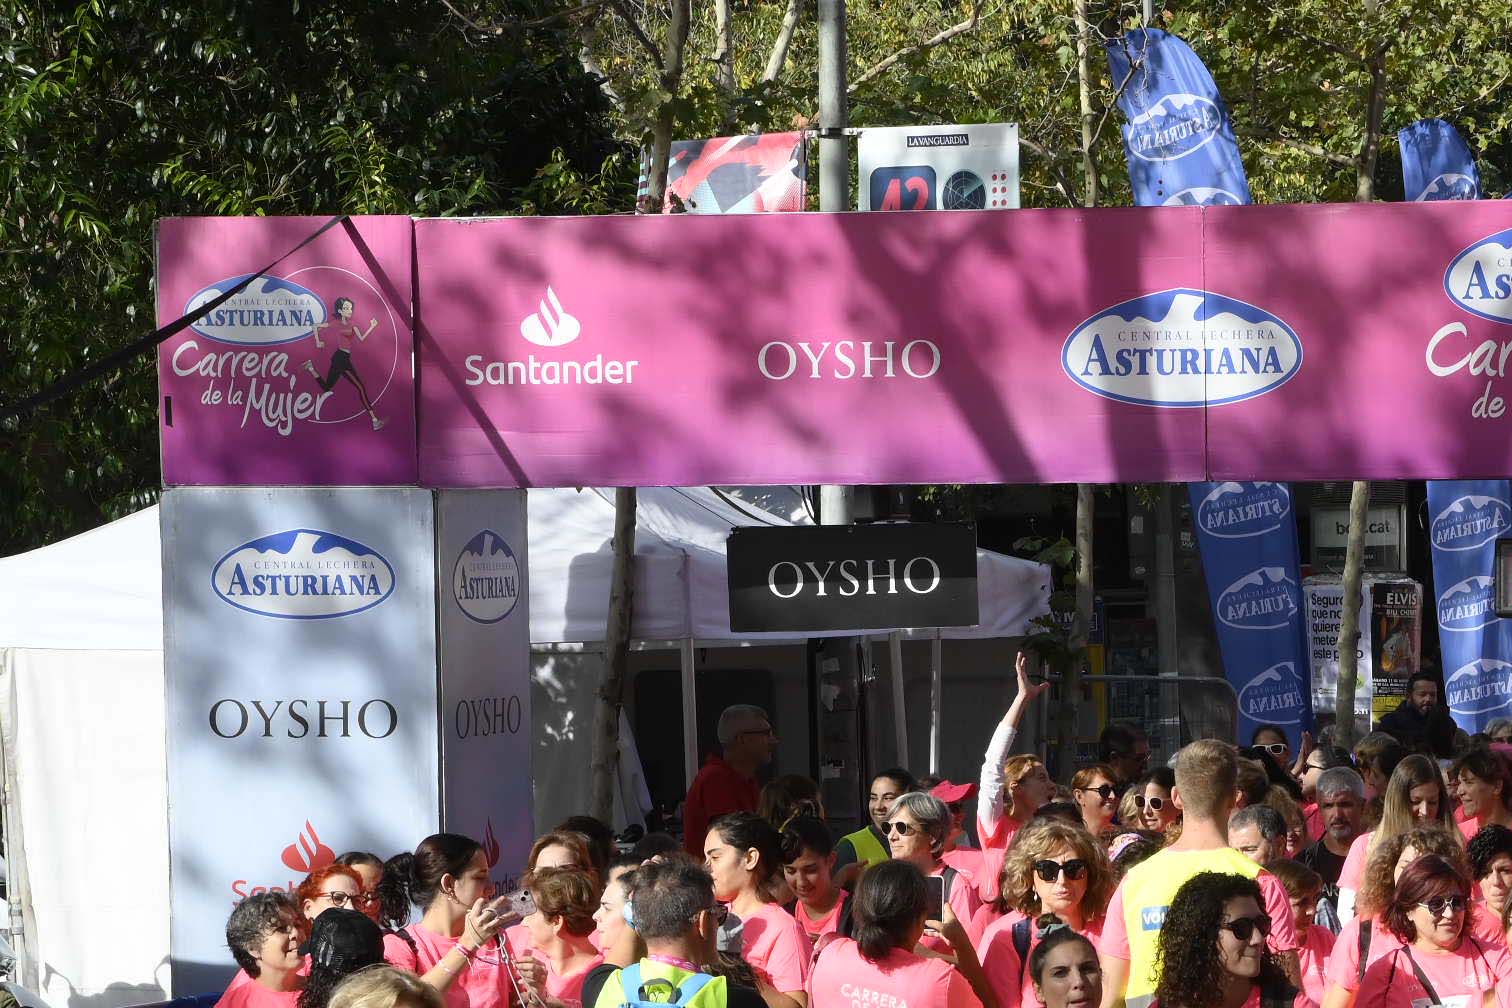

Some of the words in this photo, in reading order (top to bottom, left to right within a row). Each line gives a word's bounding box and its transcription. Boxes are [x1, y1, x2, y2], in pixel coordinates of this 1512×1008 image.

[1118, 329, 1193, 342] CENTRAL
[1200, 328, 1276, 341] LECHERA
[172, 340, 289, 377] Carrera
[465, 354, 638, 386] Santander
[757, 339, 941, 380] OYSHO
[1080, 333, 1283, 377] ASTURIANA
[201, 380, 222, 405] de
[227, 380, 242, 405] la
[241, 375, 333, 436] Mujer
[1471, 382, 1505, 419] de
[1336, 521, 1390, 535] b.cat
[227, 562, 381, 596] ASTURIANA
[254, 560, 314, 569] CENTRAL
[318, 560, 375, 569] LECHERA
[767, 557, 941, 598] OYSHO
[458, 567, 516, 600] ASTURIANA
[1386, 593, 1417, 604] ELVIS
[1313, 623, 1344, 634] quiere
[209, 699, 398, 739] OYSHO
[455, 695, 521, 739] OYSHO
